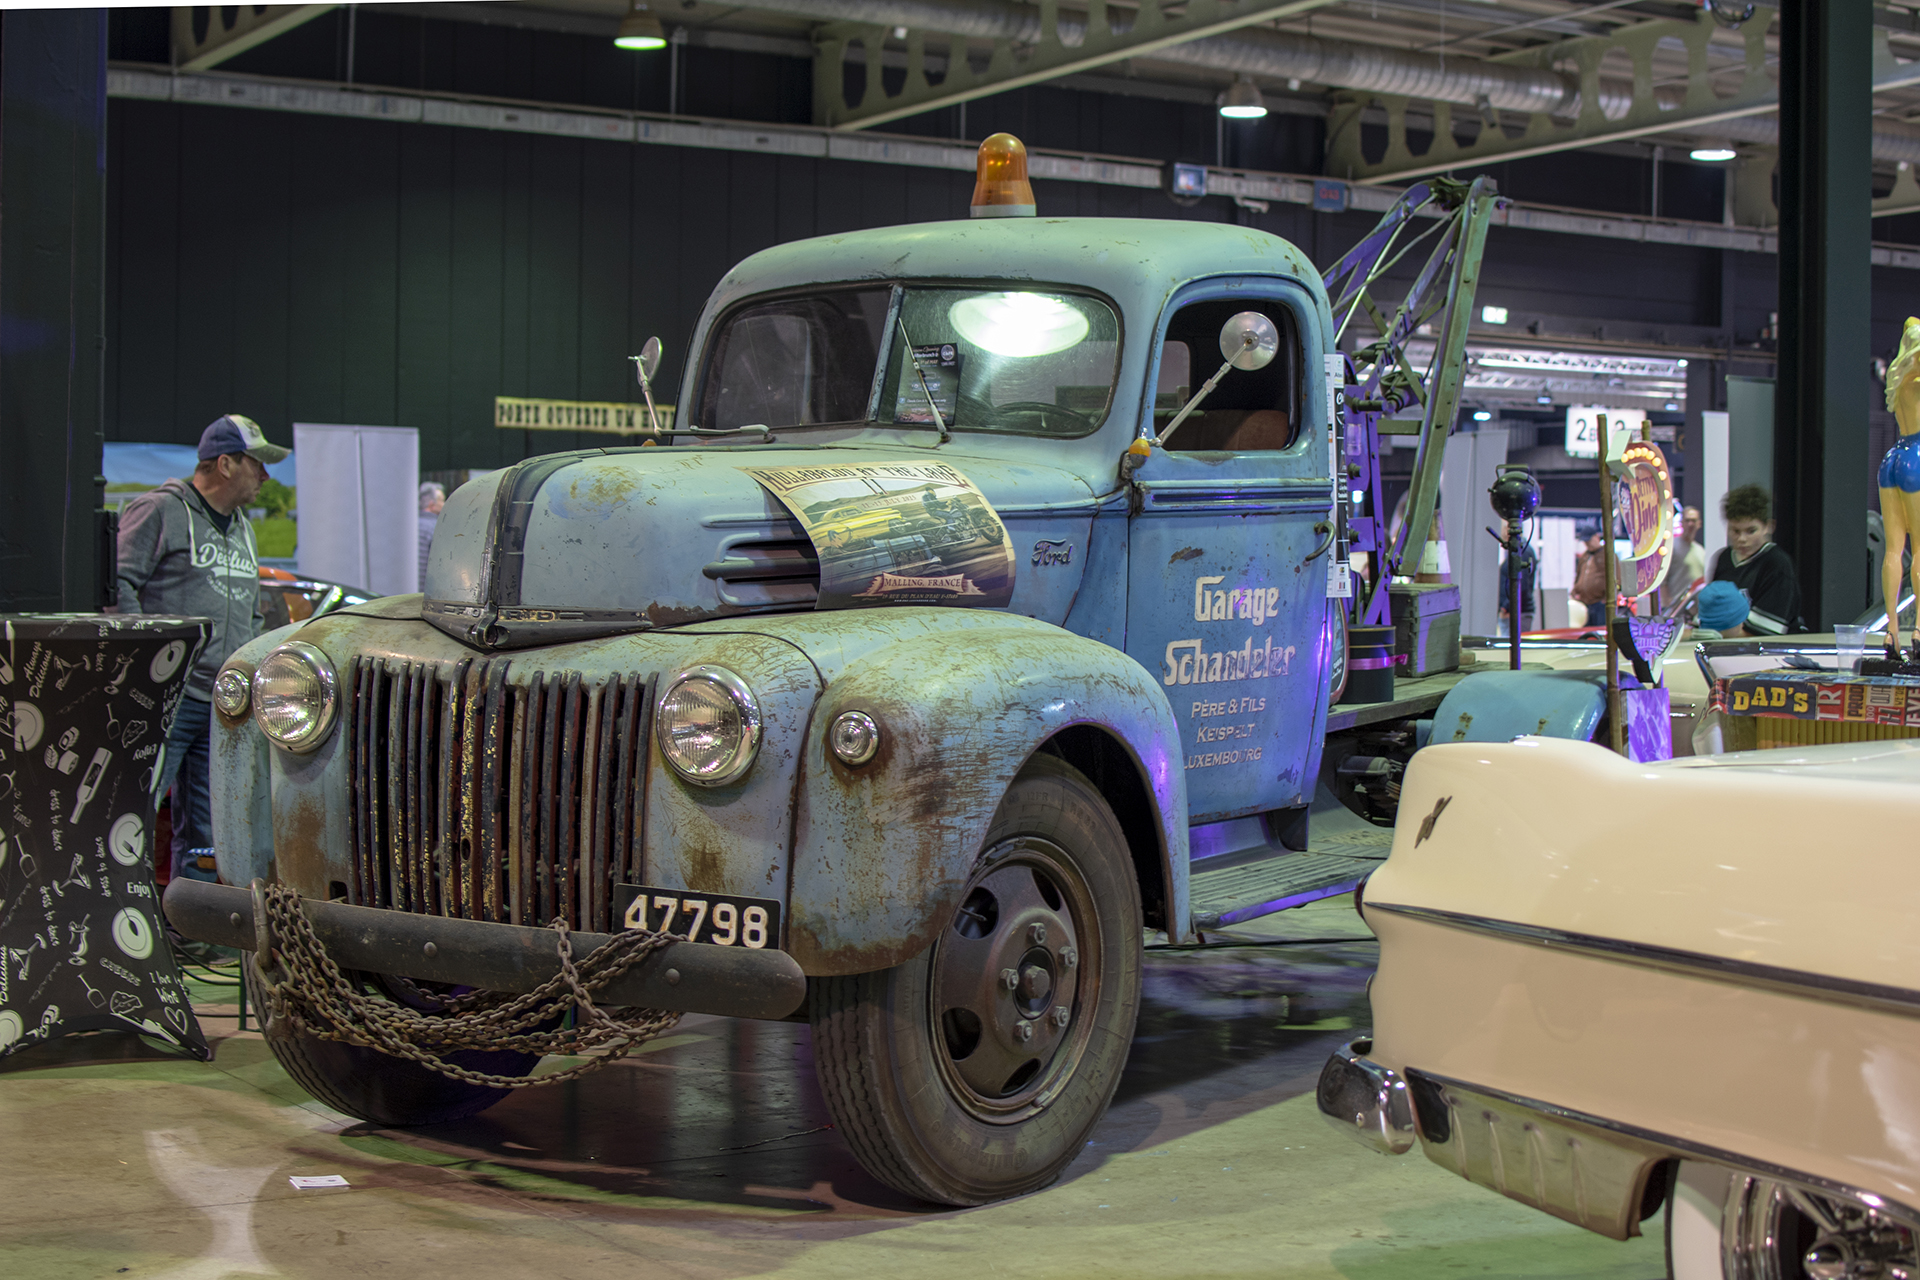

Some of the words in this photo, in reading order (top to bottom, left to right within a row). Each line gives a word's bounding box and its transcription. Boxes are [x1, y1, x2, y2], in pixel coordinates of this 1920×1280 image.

[499, 404, 539, 423] PORTE
[547, 405, 608, 427] OUVERTE
[752, 467, 856, 491] HULLABALOO
[855, 467, 880, 477] AT
[880, 466, 912, 478] THE
[913, 465, 970, 488] LAKE
[1031, 538, 1073, 567] Ford
[927, 578, 961, 587] FRANCE
[1194, 575, 1280, 626] Garage
[23, 641, 43, 681] Always
[29, 649, 52, 698] Delicious
[1163, 635, 1296, 686] Schandeler
[1227, 698, 1239, 715] &
[1733, 686, 1809, 713] DAD'S
[126, 881, 151, 898] Enjoy
[624, 894, 769, 948] 47798
